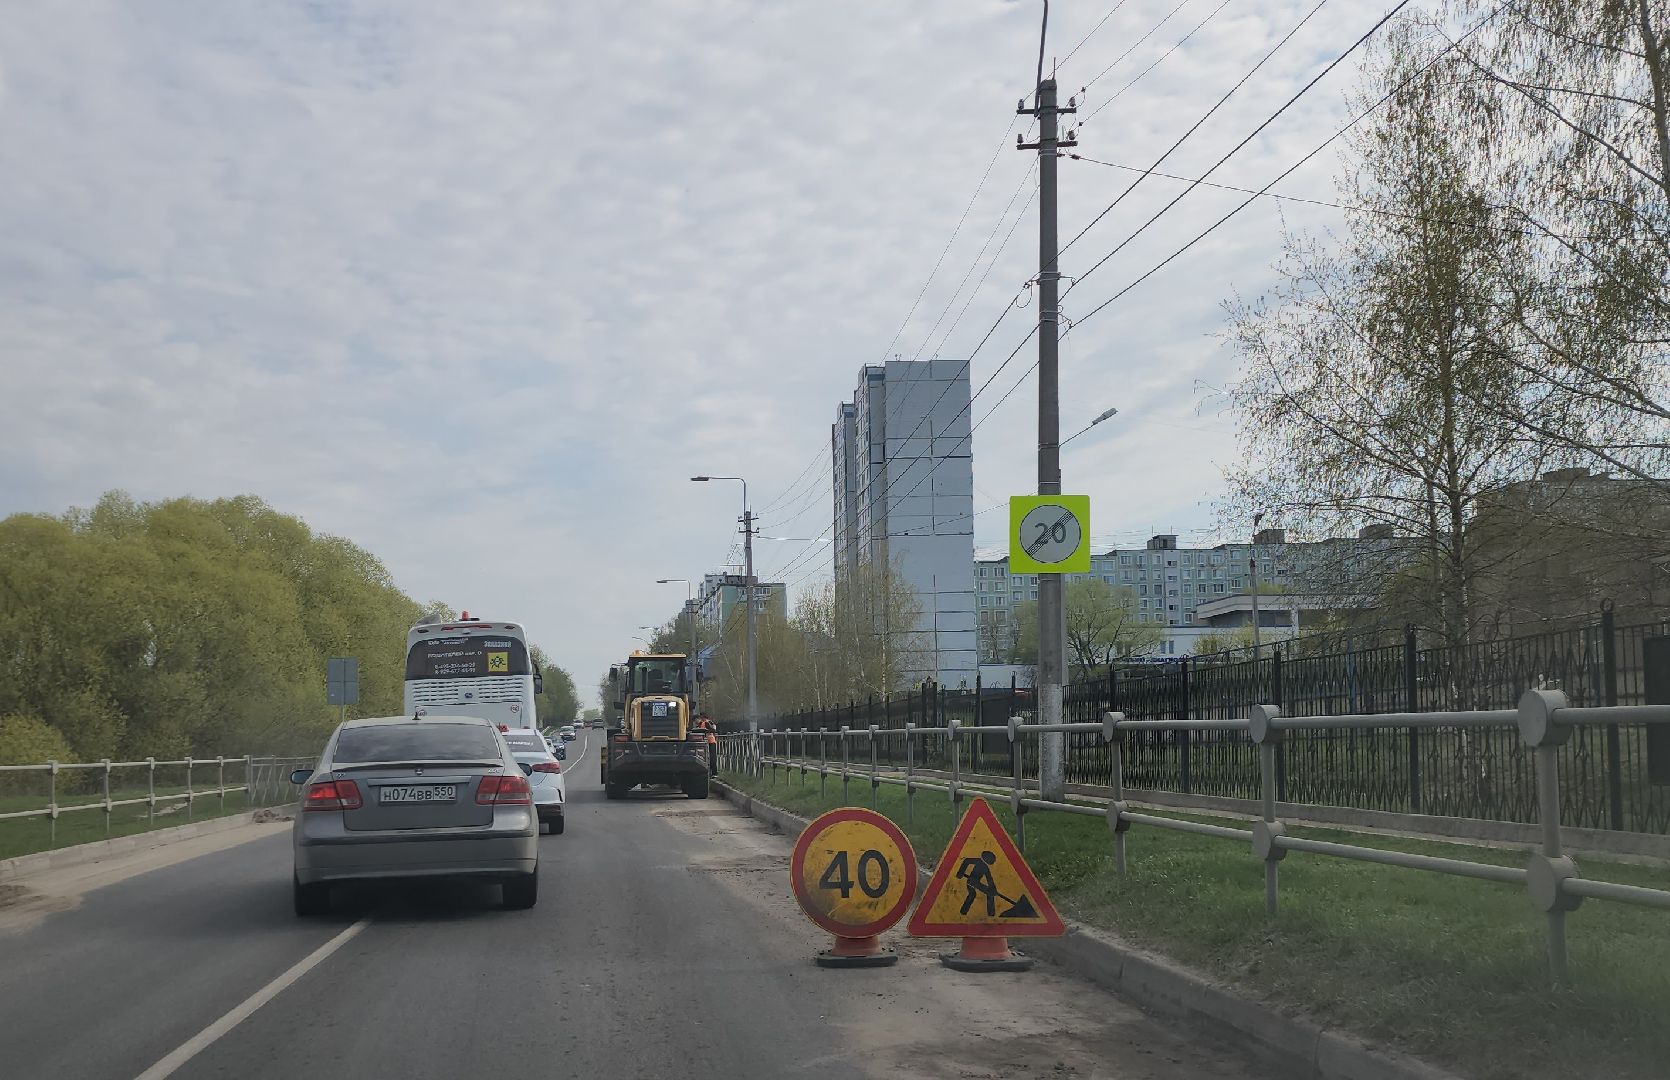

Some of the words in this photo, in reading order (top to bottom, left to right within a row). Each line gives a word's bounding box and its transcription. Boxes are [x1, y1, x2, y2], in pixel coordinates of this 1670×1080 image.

[1034, 522, 1067, 544] 20
[434, 787, 453, 796] 550
[819, 850, 890, 899] 40
